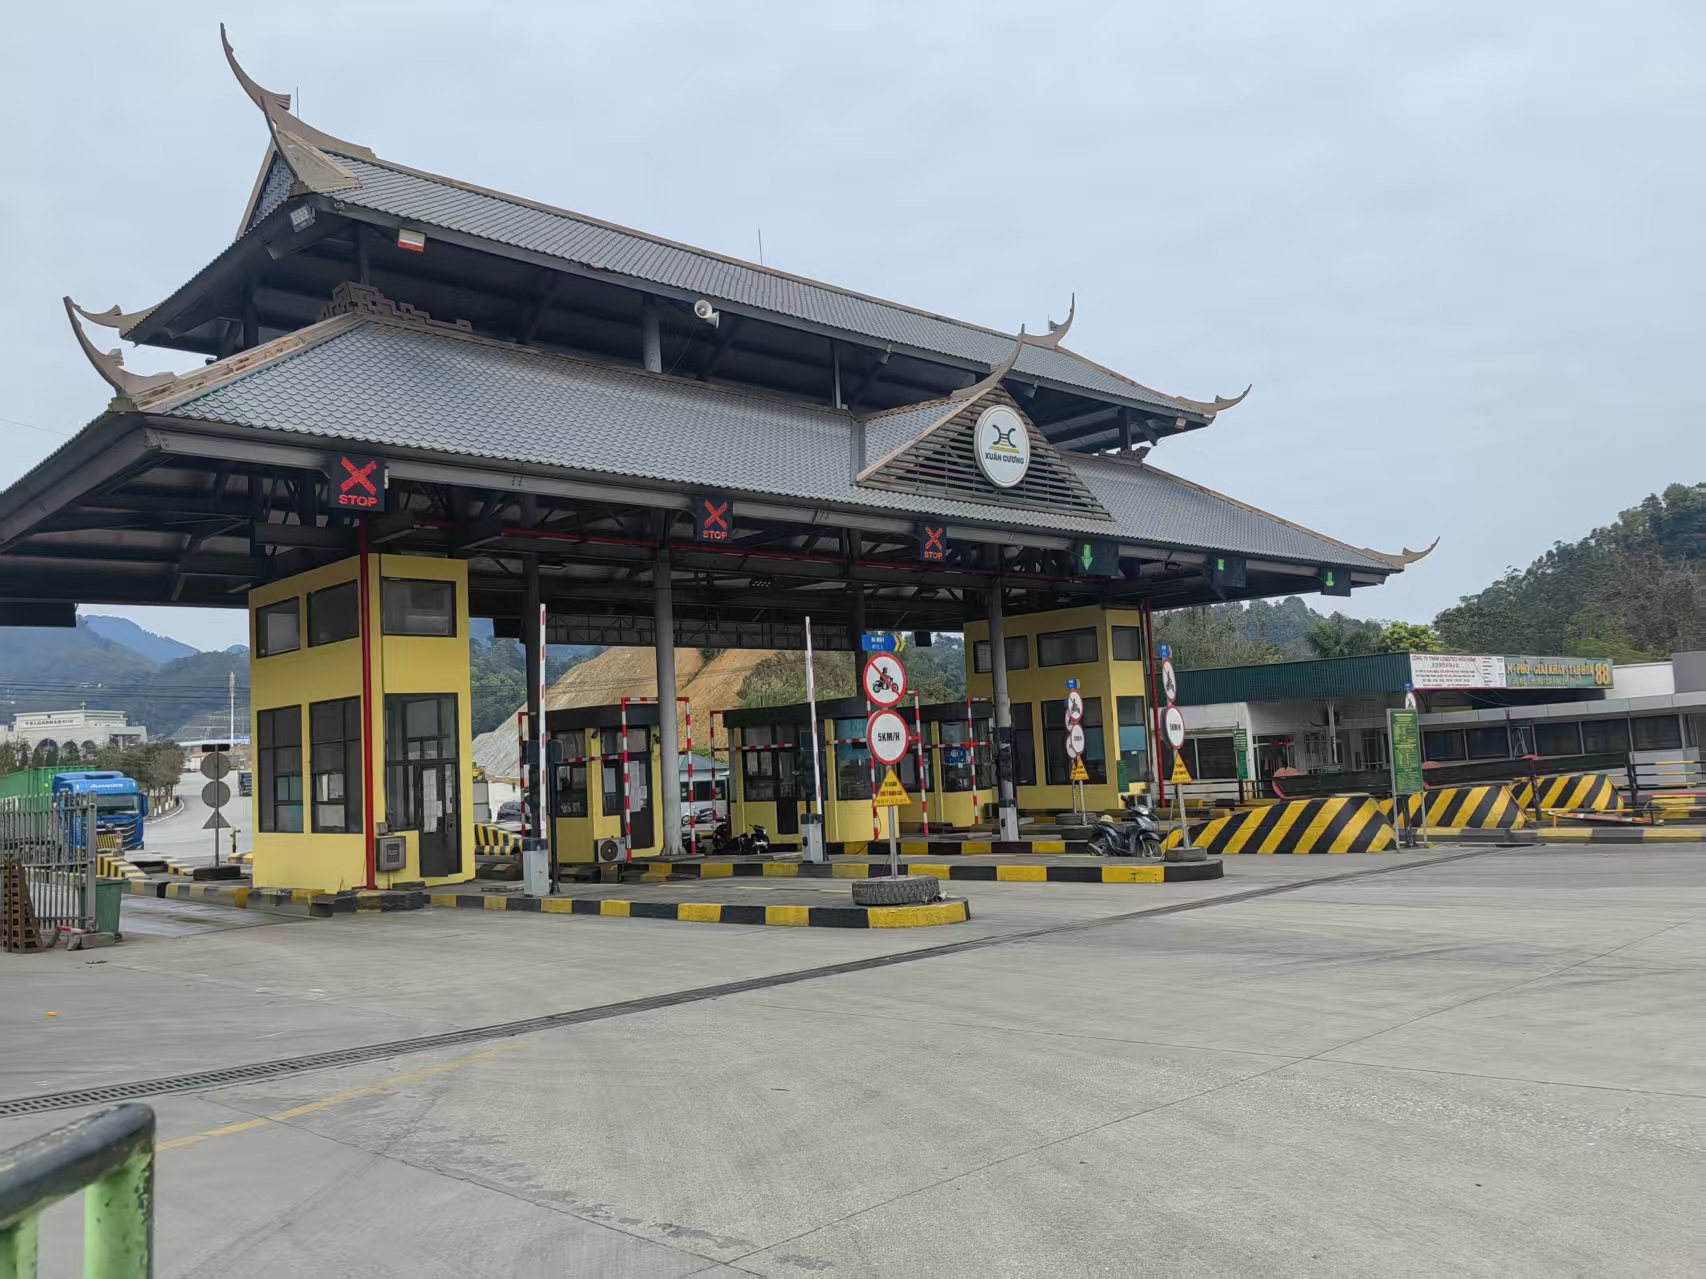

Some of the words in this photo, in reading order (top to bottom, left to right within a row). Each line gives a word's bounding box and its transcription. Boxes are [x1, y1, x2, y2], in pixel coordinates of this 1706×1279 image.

[339, 494, 378, 507] STOP
[703, 530, 728, 540] STOP
[924, 551, 943, 560] STOP
[1595, 663, 1609, 685] 88
[878, 731, 900, 742] 5KM/H
